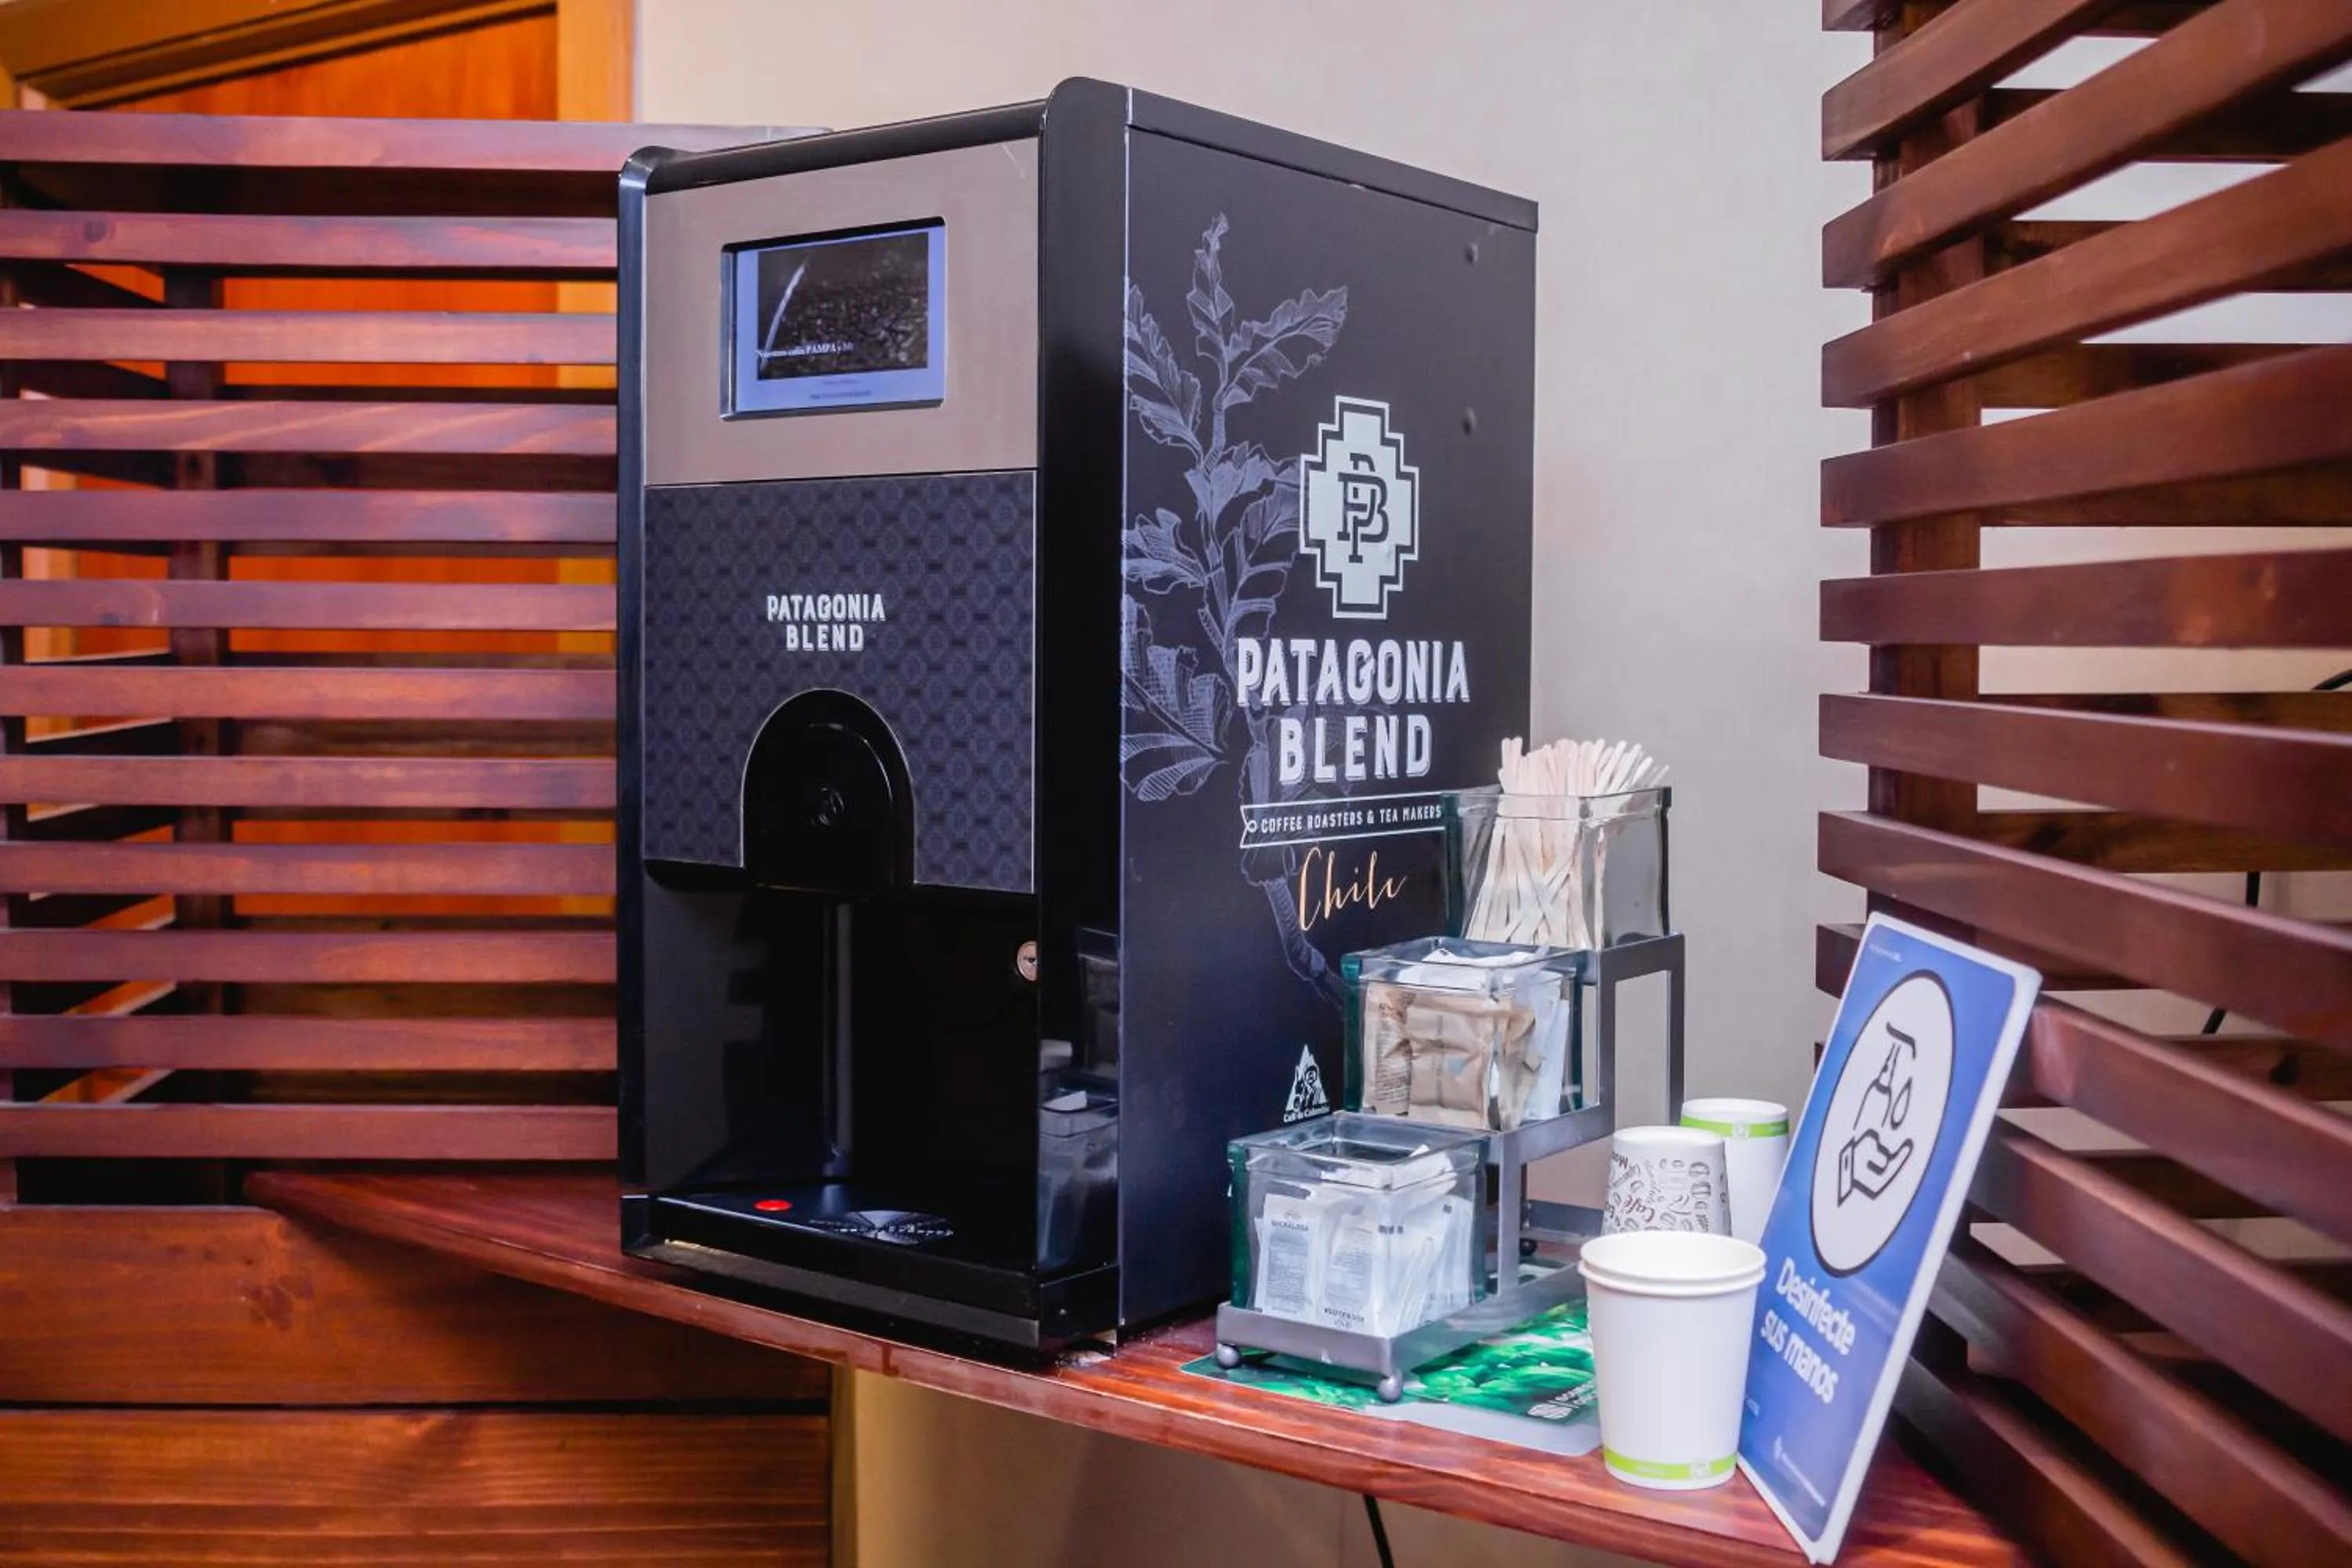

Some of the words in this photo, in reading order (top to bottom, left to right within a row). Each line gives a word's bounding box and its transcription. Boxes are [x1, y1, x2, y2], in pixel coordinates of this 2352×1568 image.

[767, 593, 886, 622] PATAGONIA
[786, 624, 864, 652] BLEND
[1236, 637, 1471, 706] PATAGONIA
[1279, 714, 1432, 786] BLEND
[1261, 815, 1302, 834] COFFEE
[1307, 811, 1363, 830] ROASTERS
[1367, 808, 1374, 824] &
[1379, 808, 1399, 823] TEA
[1403, 804, 1442, 822] MAKERS
[1298, 846, 1408, 931] Chile
[1774, 1257, 1856, 1356] Desinfecte
[1760, 1308, 1789, 1354] sus
[1784, 1332, 1839, 1404] manos
